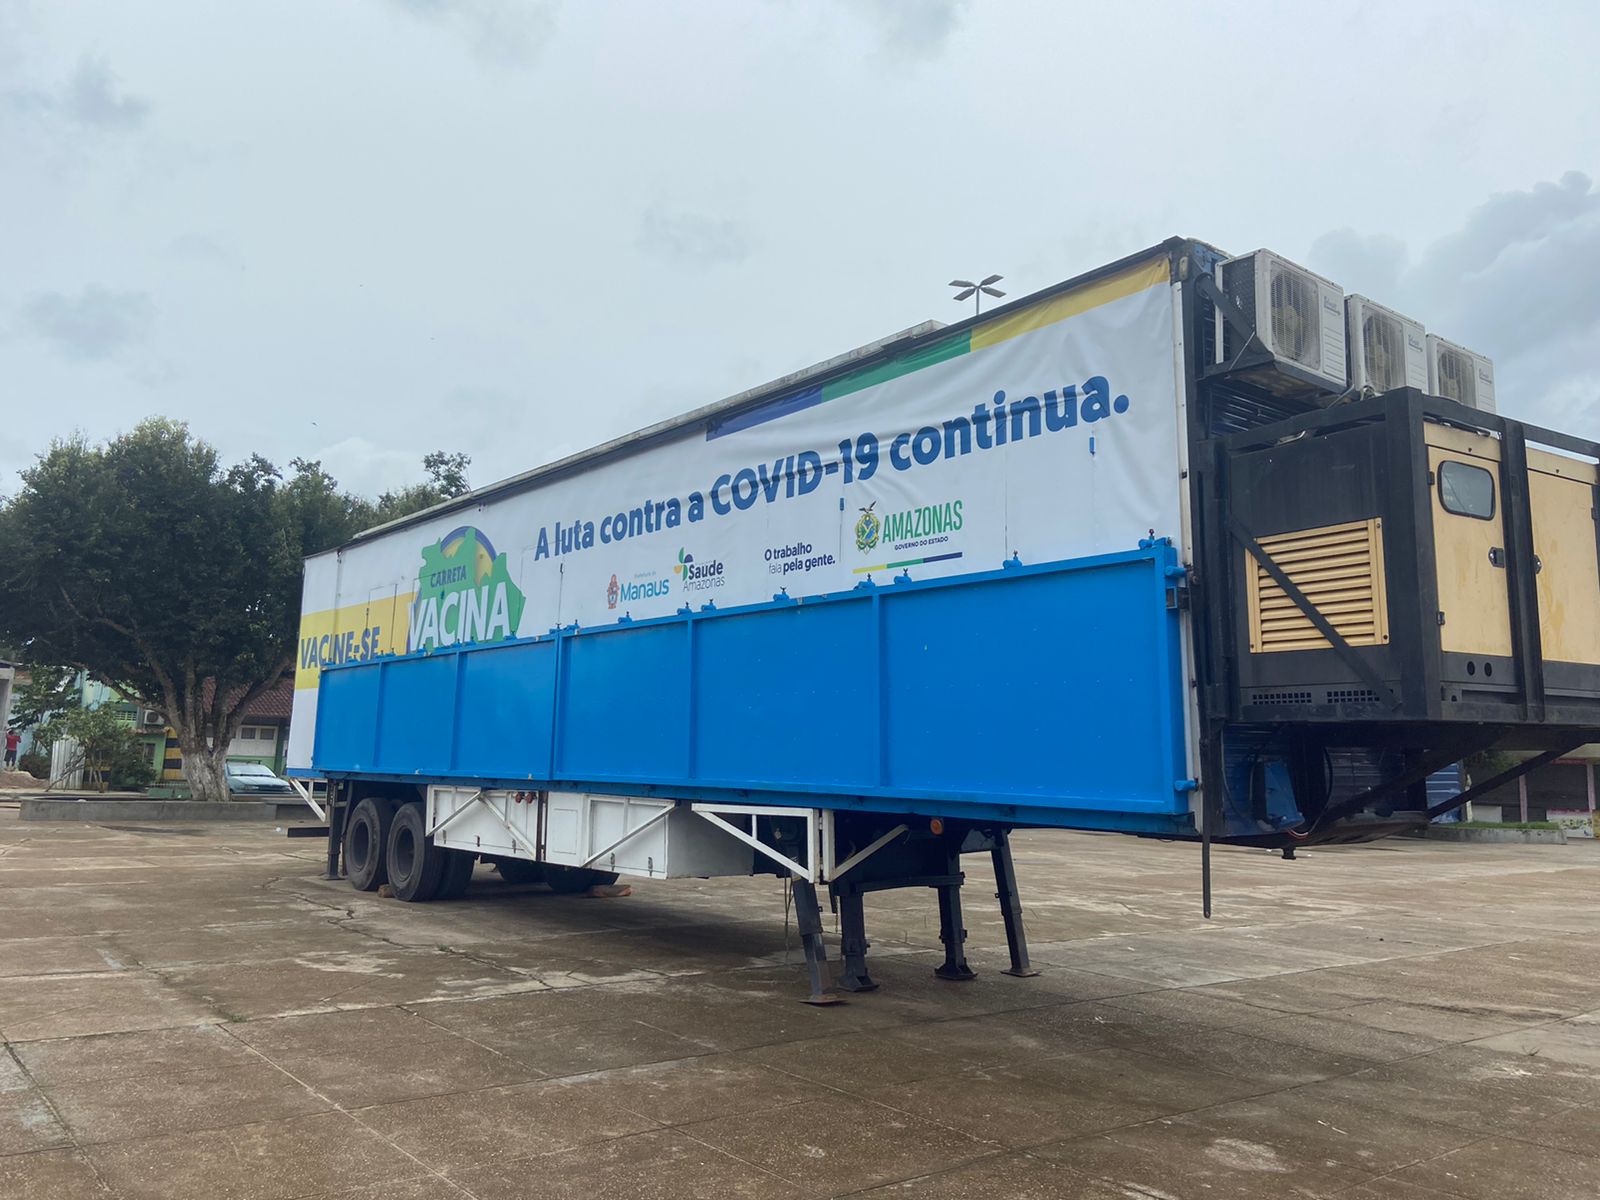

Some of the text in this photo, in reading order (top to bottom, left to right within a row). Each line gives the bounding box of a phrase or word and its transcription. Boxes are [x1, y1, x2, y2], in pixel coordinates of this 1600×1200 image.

[534, 375, 1130, 561] A luta contra a COVID-19 continua.
[882, 499, 963, 544] AMAZONAS
[764, 542, 812, 561] O trabalho
[894, 536, 949, 551] GOVERNO DO ESTADO
[430, 565, 467, 588] CARRETA
[783, 558, 803, 576] pela
[805, 554, 836, 571] gente.
[620, 578, 669, 603] Manaus
[683, 576, 725, 593] Amazonas
[408, 581, 511, 651] VACINA
[301, 626, 380, 670] VACINE-SE
